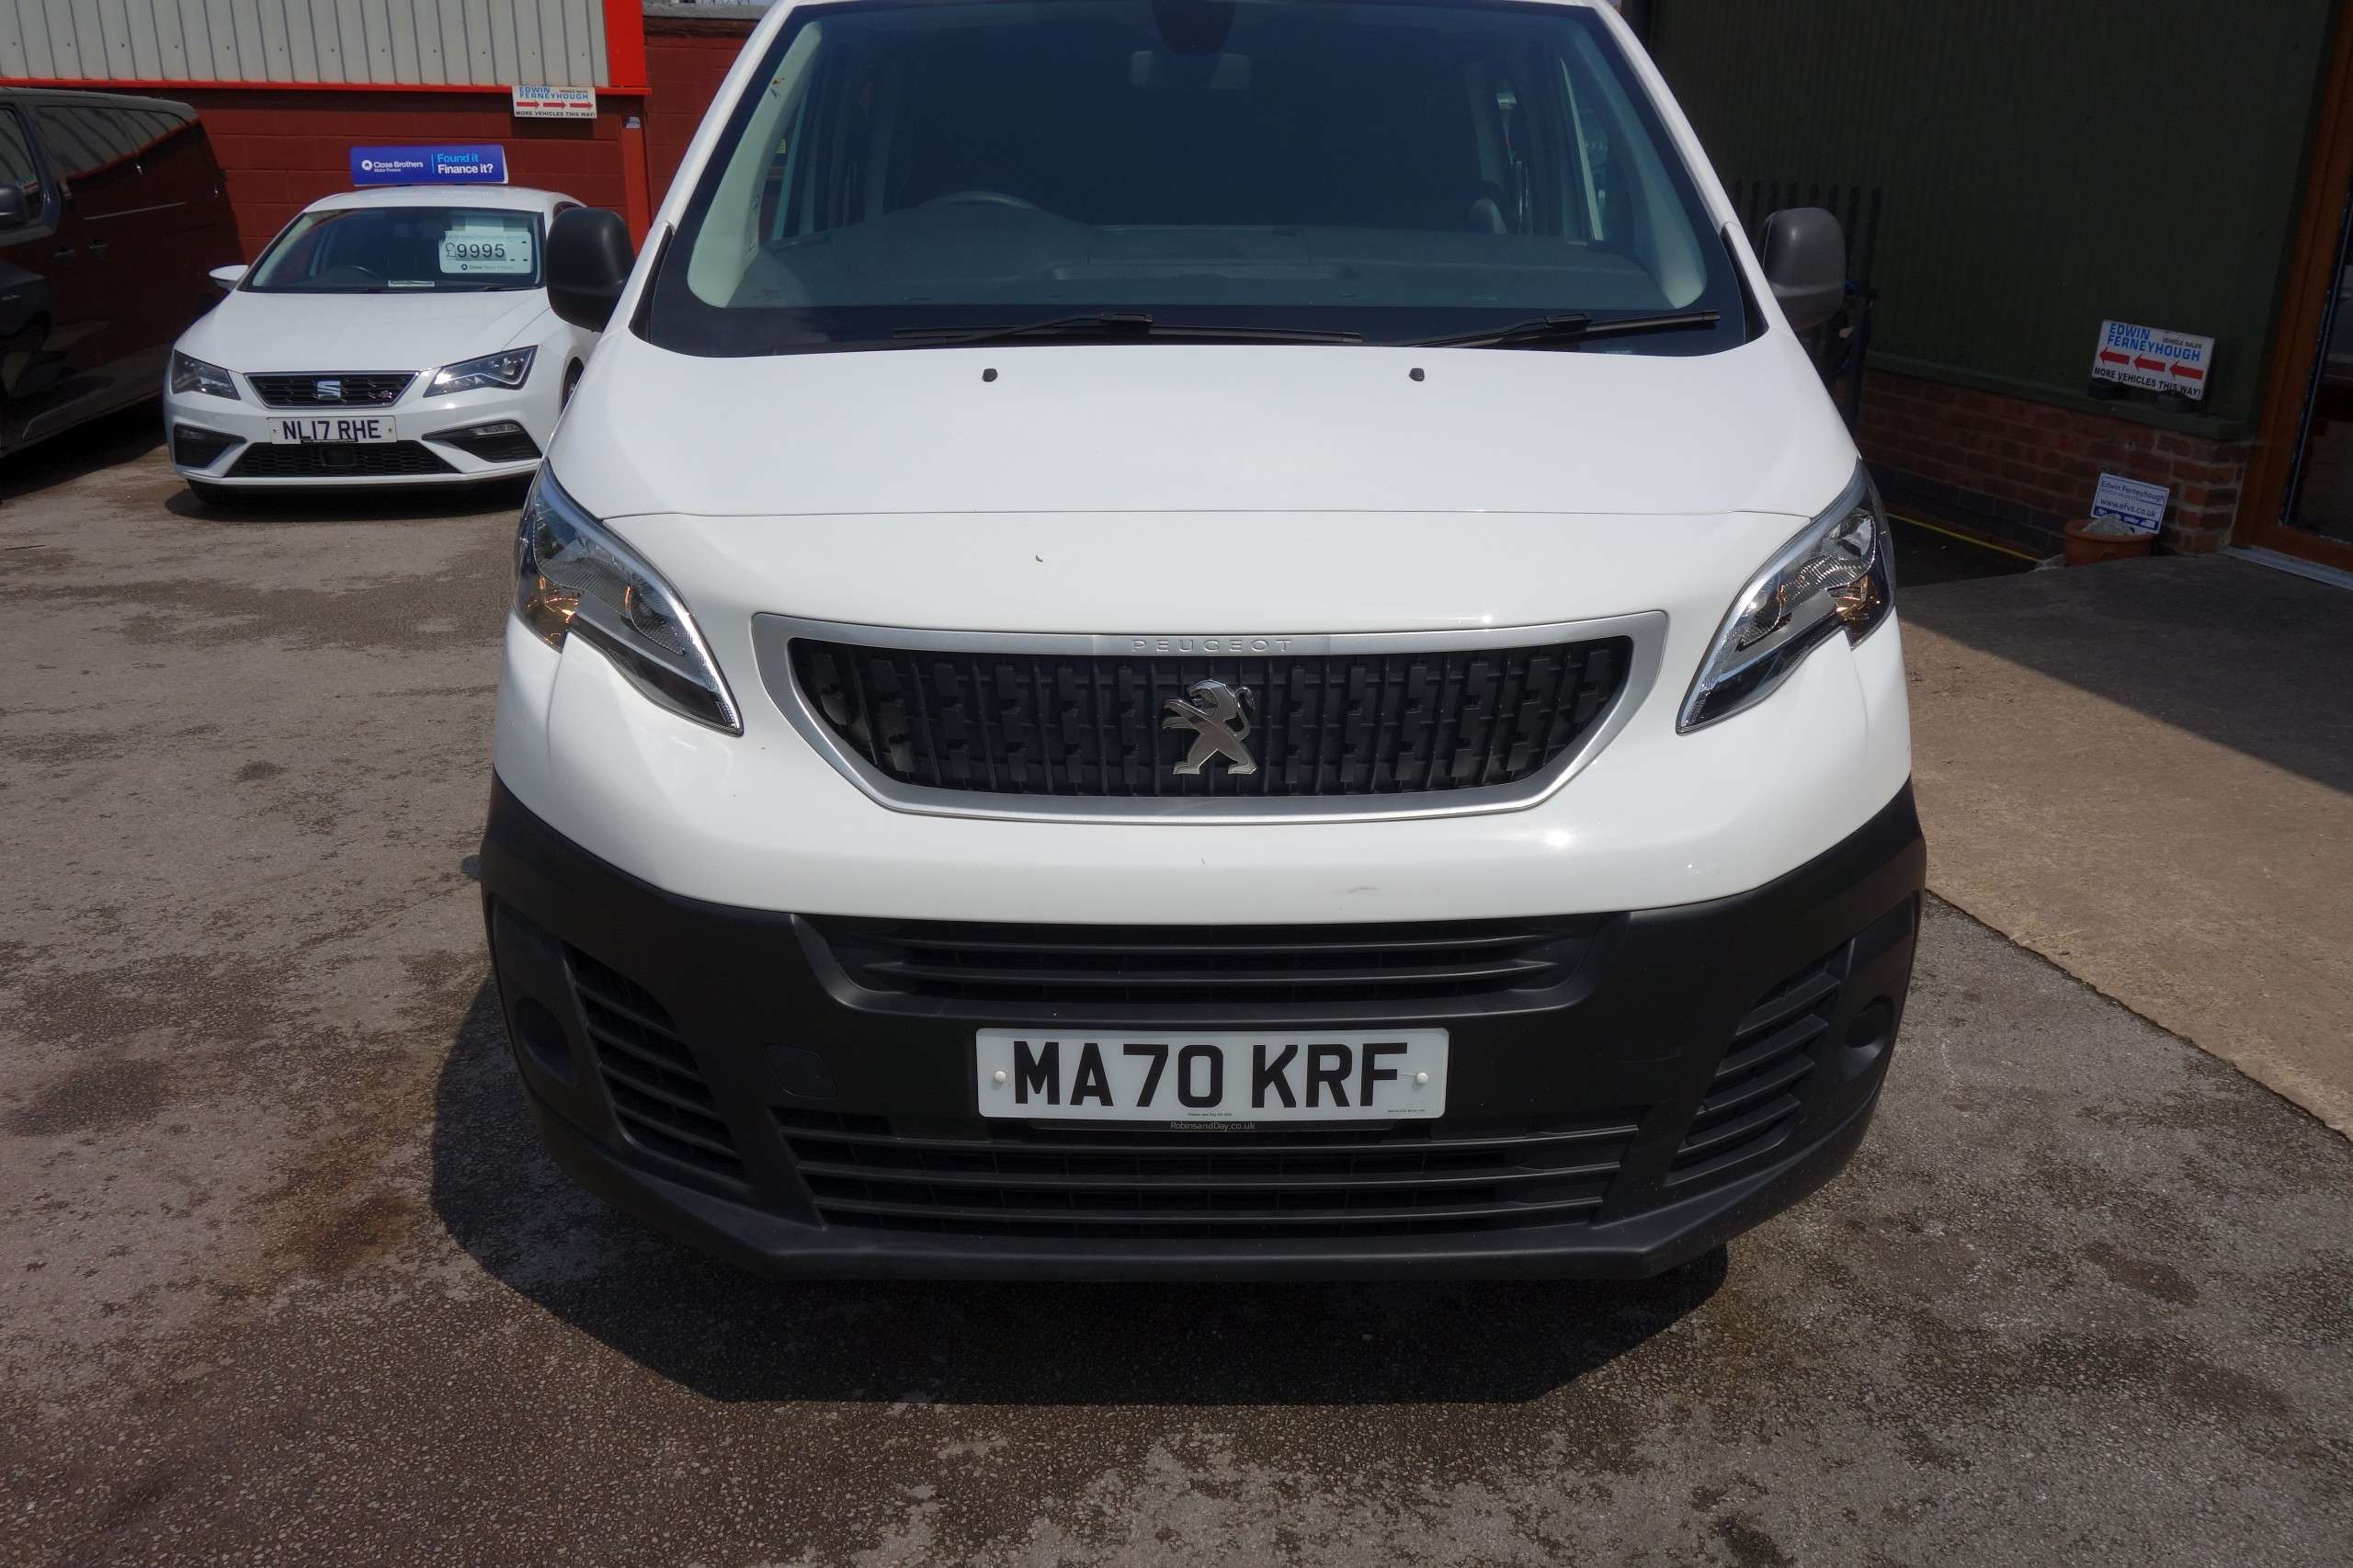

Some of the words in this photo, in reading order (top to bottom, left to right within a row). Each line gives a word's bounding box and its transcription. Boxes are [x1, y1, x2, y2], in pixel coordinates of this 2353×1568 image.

[393, 160, 424, 168] Brothers
[438, 153, 470, 163] Found
[472, 153, 479, 162] it
[438, 164, 478, 174] Finance
[480, 163, 494, 174] it?
[2109, 323, 2151, 340] EDWIN
[2107, 335, 2201, 362] FERNEYHOUGH
[2094, 368, 2116, 379] MORE
[2118, 372, 2156, 387] VEHICLES
[2159, 381, 2177, 392] THIS
[2179, 385, 2202, 398] WAY!
[282, 420, 331, 440] NL17
[337, 419, 381, 440] RHE
[1131, 639, 1291, 653] PEUGEOT
[1013, 1040, 1224, 1108] MA70
[1252, 1041, 1408, 1108] KRF
